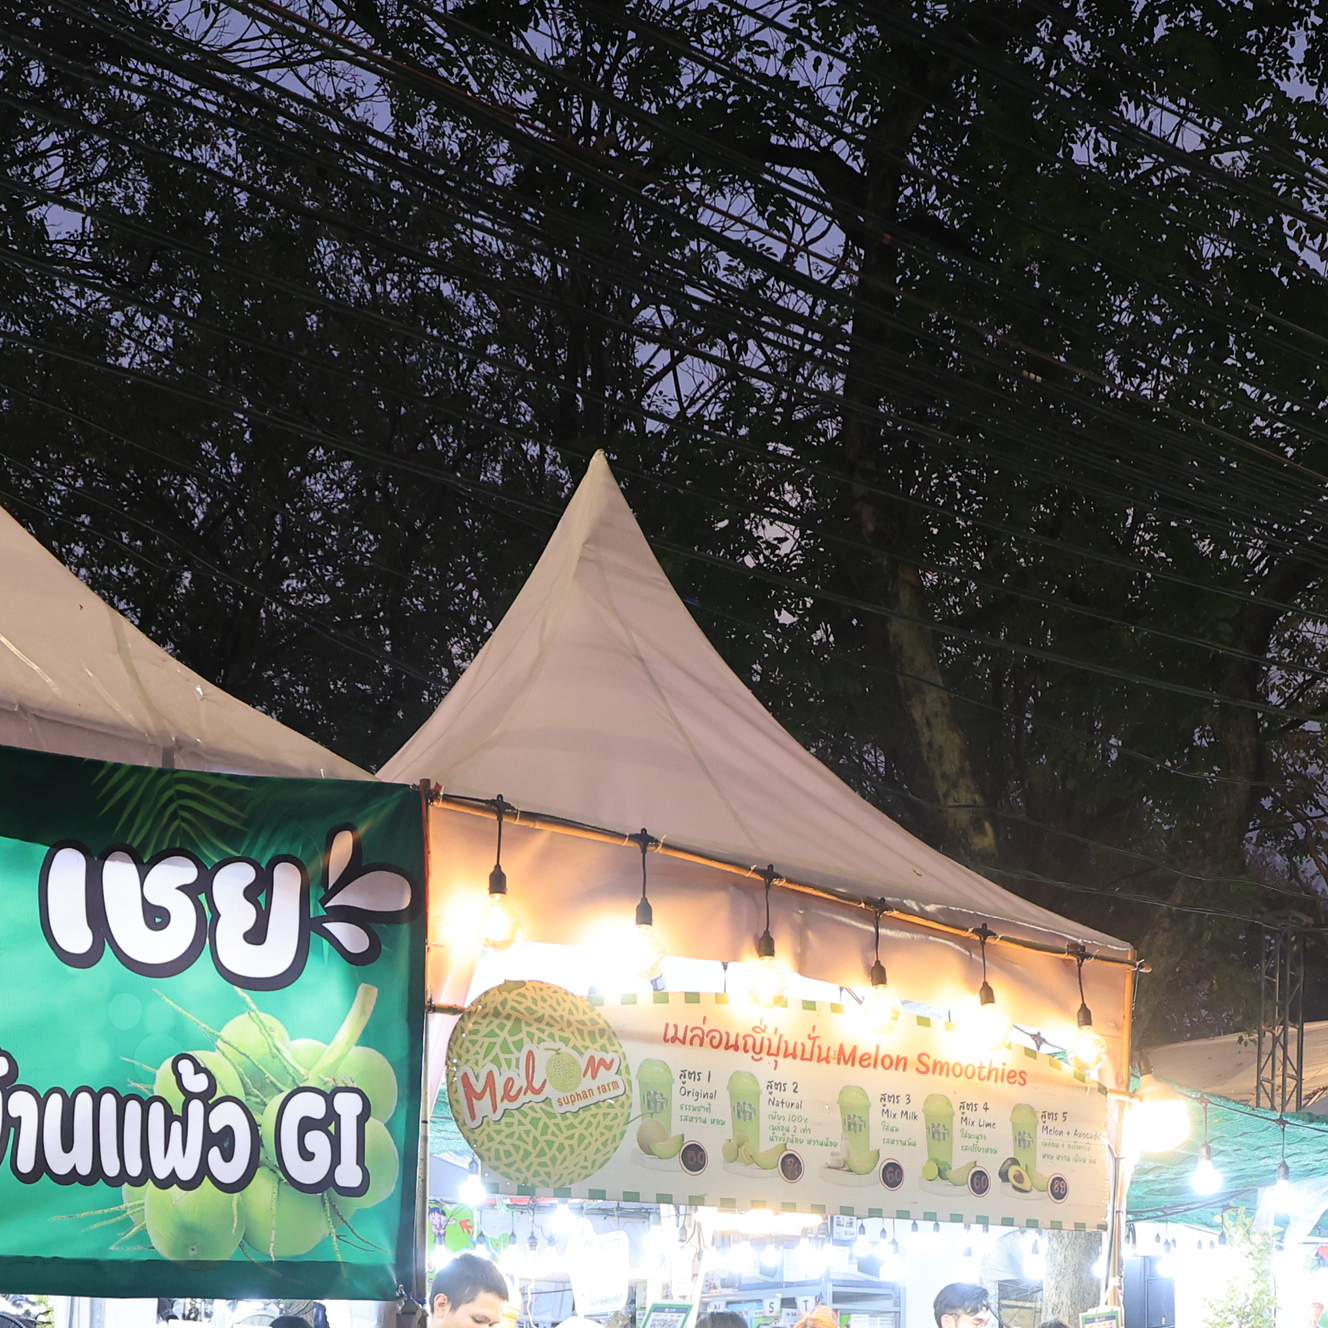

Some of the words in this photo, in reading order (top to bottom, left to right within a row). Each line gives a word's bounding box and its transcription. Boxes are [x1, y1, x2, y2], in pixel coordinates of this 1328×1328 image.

[38, 844, 308, 989] เชย
[663, 1016, 830, 1070] เมล่อนญี่ปุ่นปั่น
[837, 1043, 908, 1072] Melon
[915, 1052, 1028, 1086] Smoothies
[679, 1068, 702, 1085] สูตร
[707, 1070, 712, 1083] 1
[556, 1089, 595, 1107] suphan
[597, 1080, 620, 1095] farm
[679, 1086, 717, 1101] Original
[766, 1080, 787, 1096] สูตร
[792, 1081, 799, 1094] 2
[768, 1097, 803, 1110] Natural
[880, 1093, 901, 1107] สูตร
[905, 1093, 912, 1104] 3
[881, 1108, 897, 1120] Mix
[900, 1110, 919, 1121] Milk
[959, 1101, 979, 1115] สูตร
[982, 1101, 990, 1112] 4
[960, 1116, 976, 1127] Mix
[978, 1118, 997, 1130] Lime
[1040, 1110, 1059, 1123] สูตร
[1062, 1111, 1068, 1122] 5
[1041, 1125, 1064, 1137] Melon
[275, 1083, 370, 1197] GI
[974, 1176, 988, 1190] 60
[1053, 1181, 1067, 1194] 89
